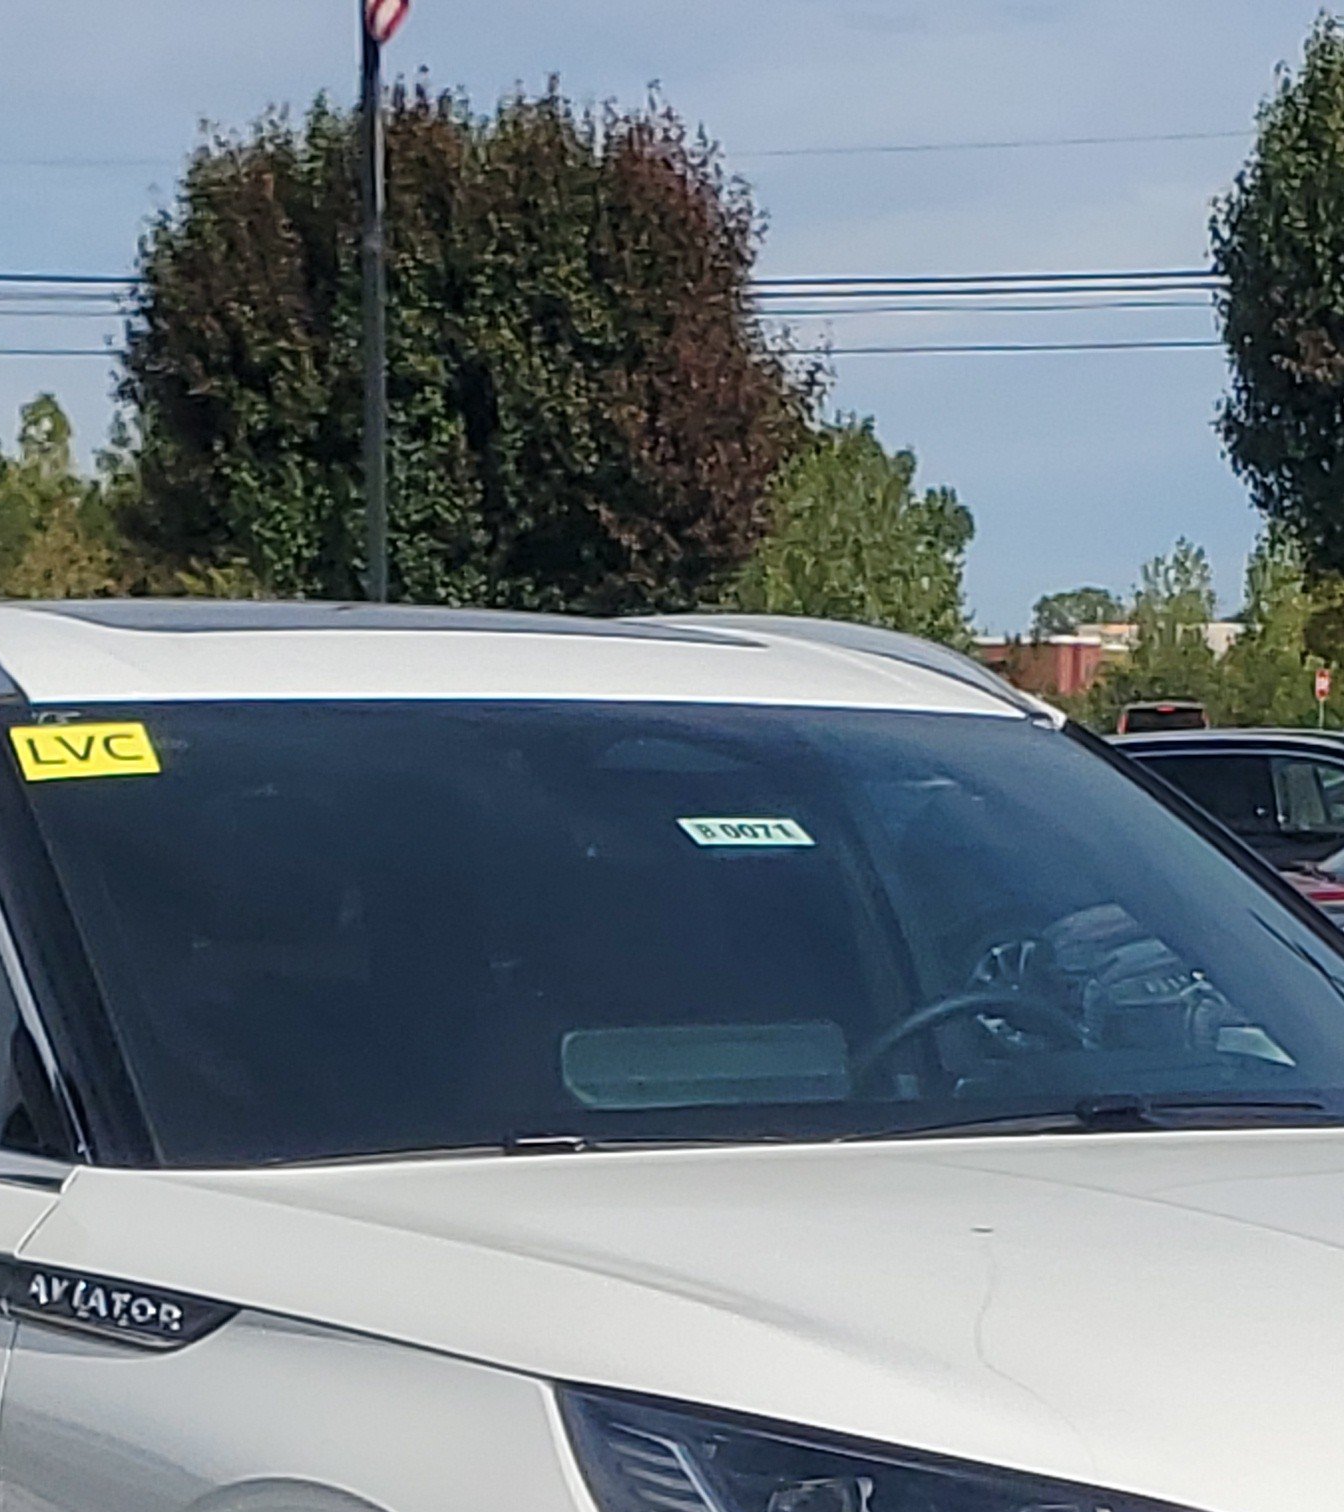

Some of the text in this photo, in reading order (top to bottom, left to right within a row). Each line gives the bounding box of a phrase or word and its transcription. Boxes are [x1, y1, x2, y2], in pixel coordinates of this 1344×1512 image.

[25, 732, 144, 765] LVC
[718, 823, 794, 839] 0071
[28, 1272, 184, 1332] AVIATOR
